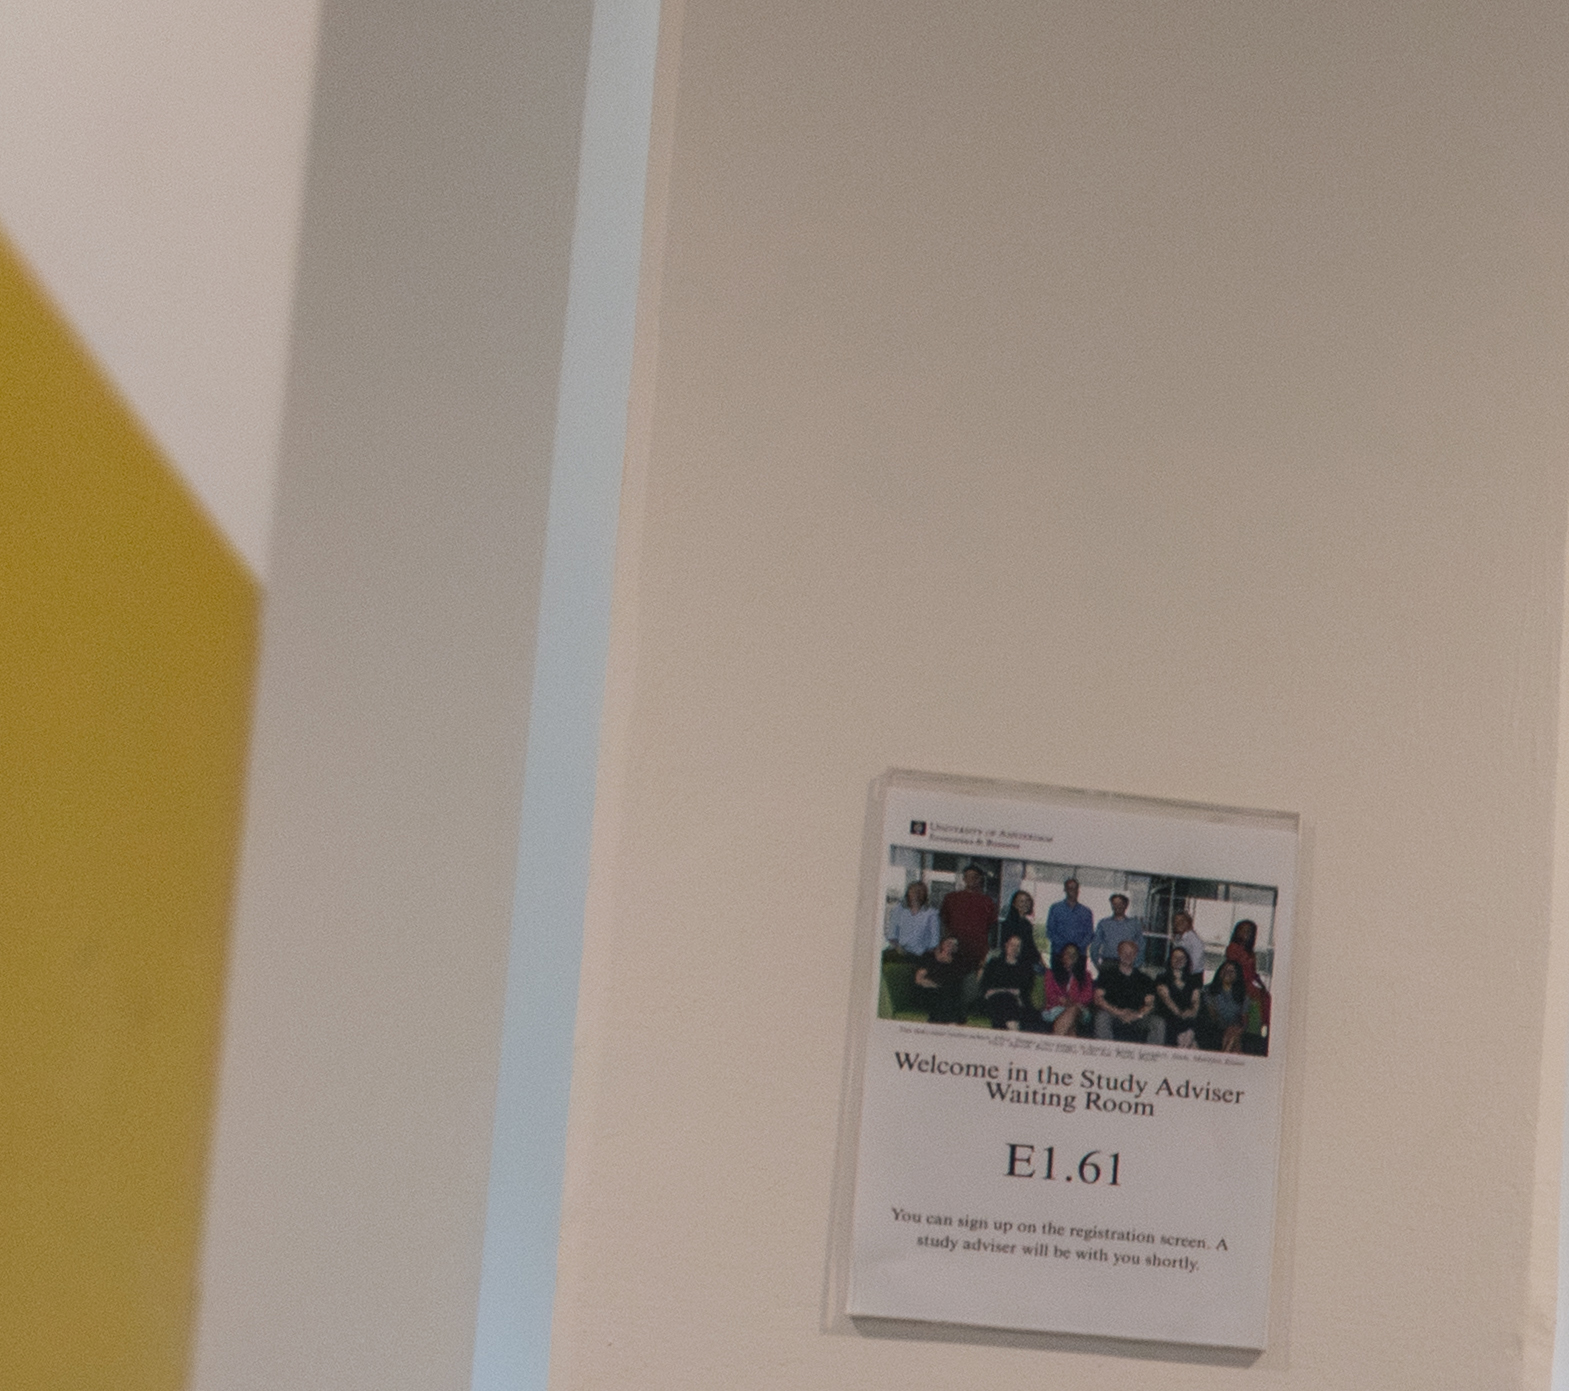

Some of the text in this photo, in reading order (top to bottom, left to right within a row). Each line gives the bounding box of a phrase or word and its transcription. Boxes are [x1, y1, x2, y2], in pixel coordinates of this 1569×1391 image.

[895, 1052, 1244, 1103] Welcome in the Study Adviser
[986, 1081, 1153, 1116] Waiting Room
[1005, 1143, 1120, 1186] E1.61
[892, 1208, 921, 1223] You
[926, 1215, 953, 1226] can
[958, 1215, 988, 1231] sign
[994, 1221, 1013, 1234] up
[1018, 1223, 1036, 1233] on
[1042, 1222, 1065, 1236] the
[1070, 1226, 1155, 1244] registration
[1216, 1238, 1228, 1251] A
[917, 1236, 1200, 1273] study adviser will be with you shortly.
